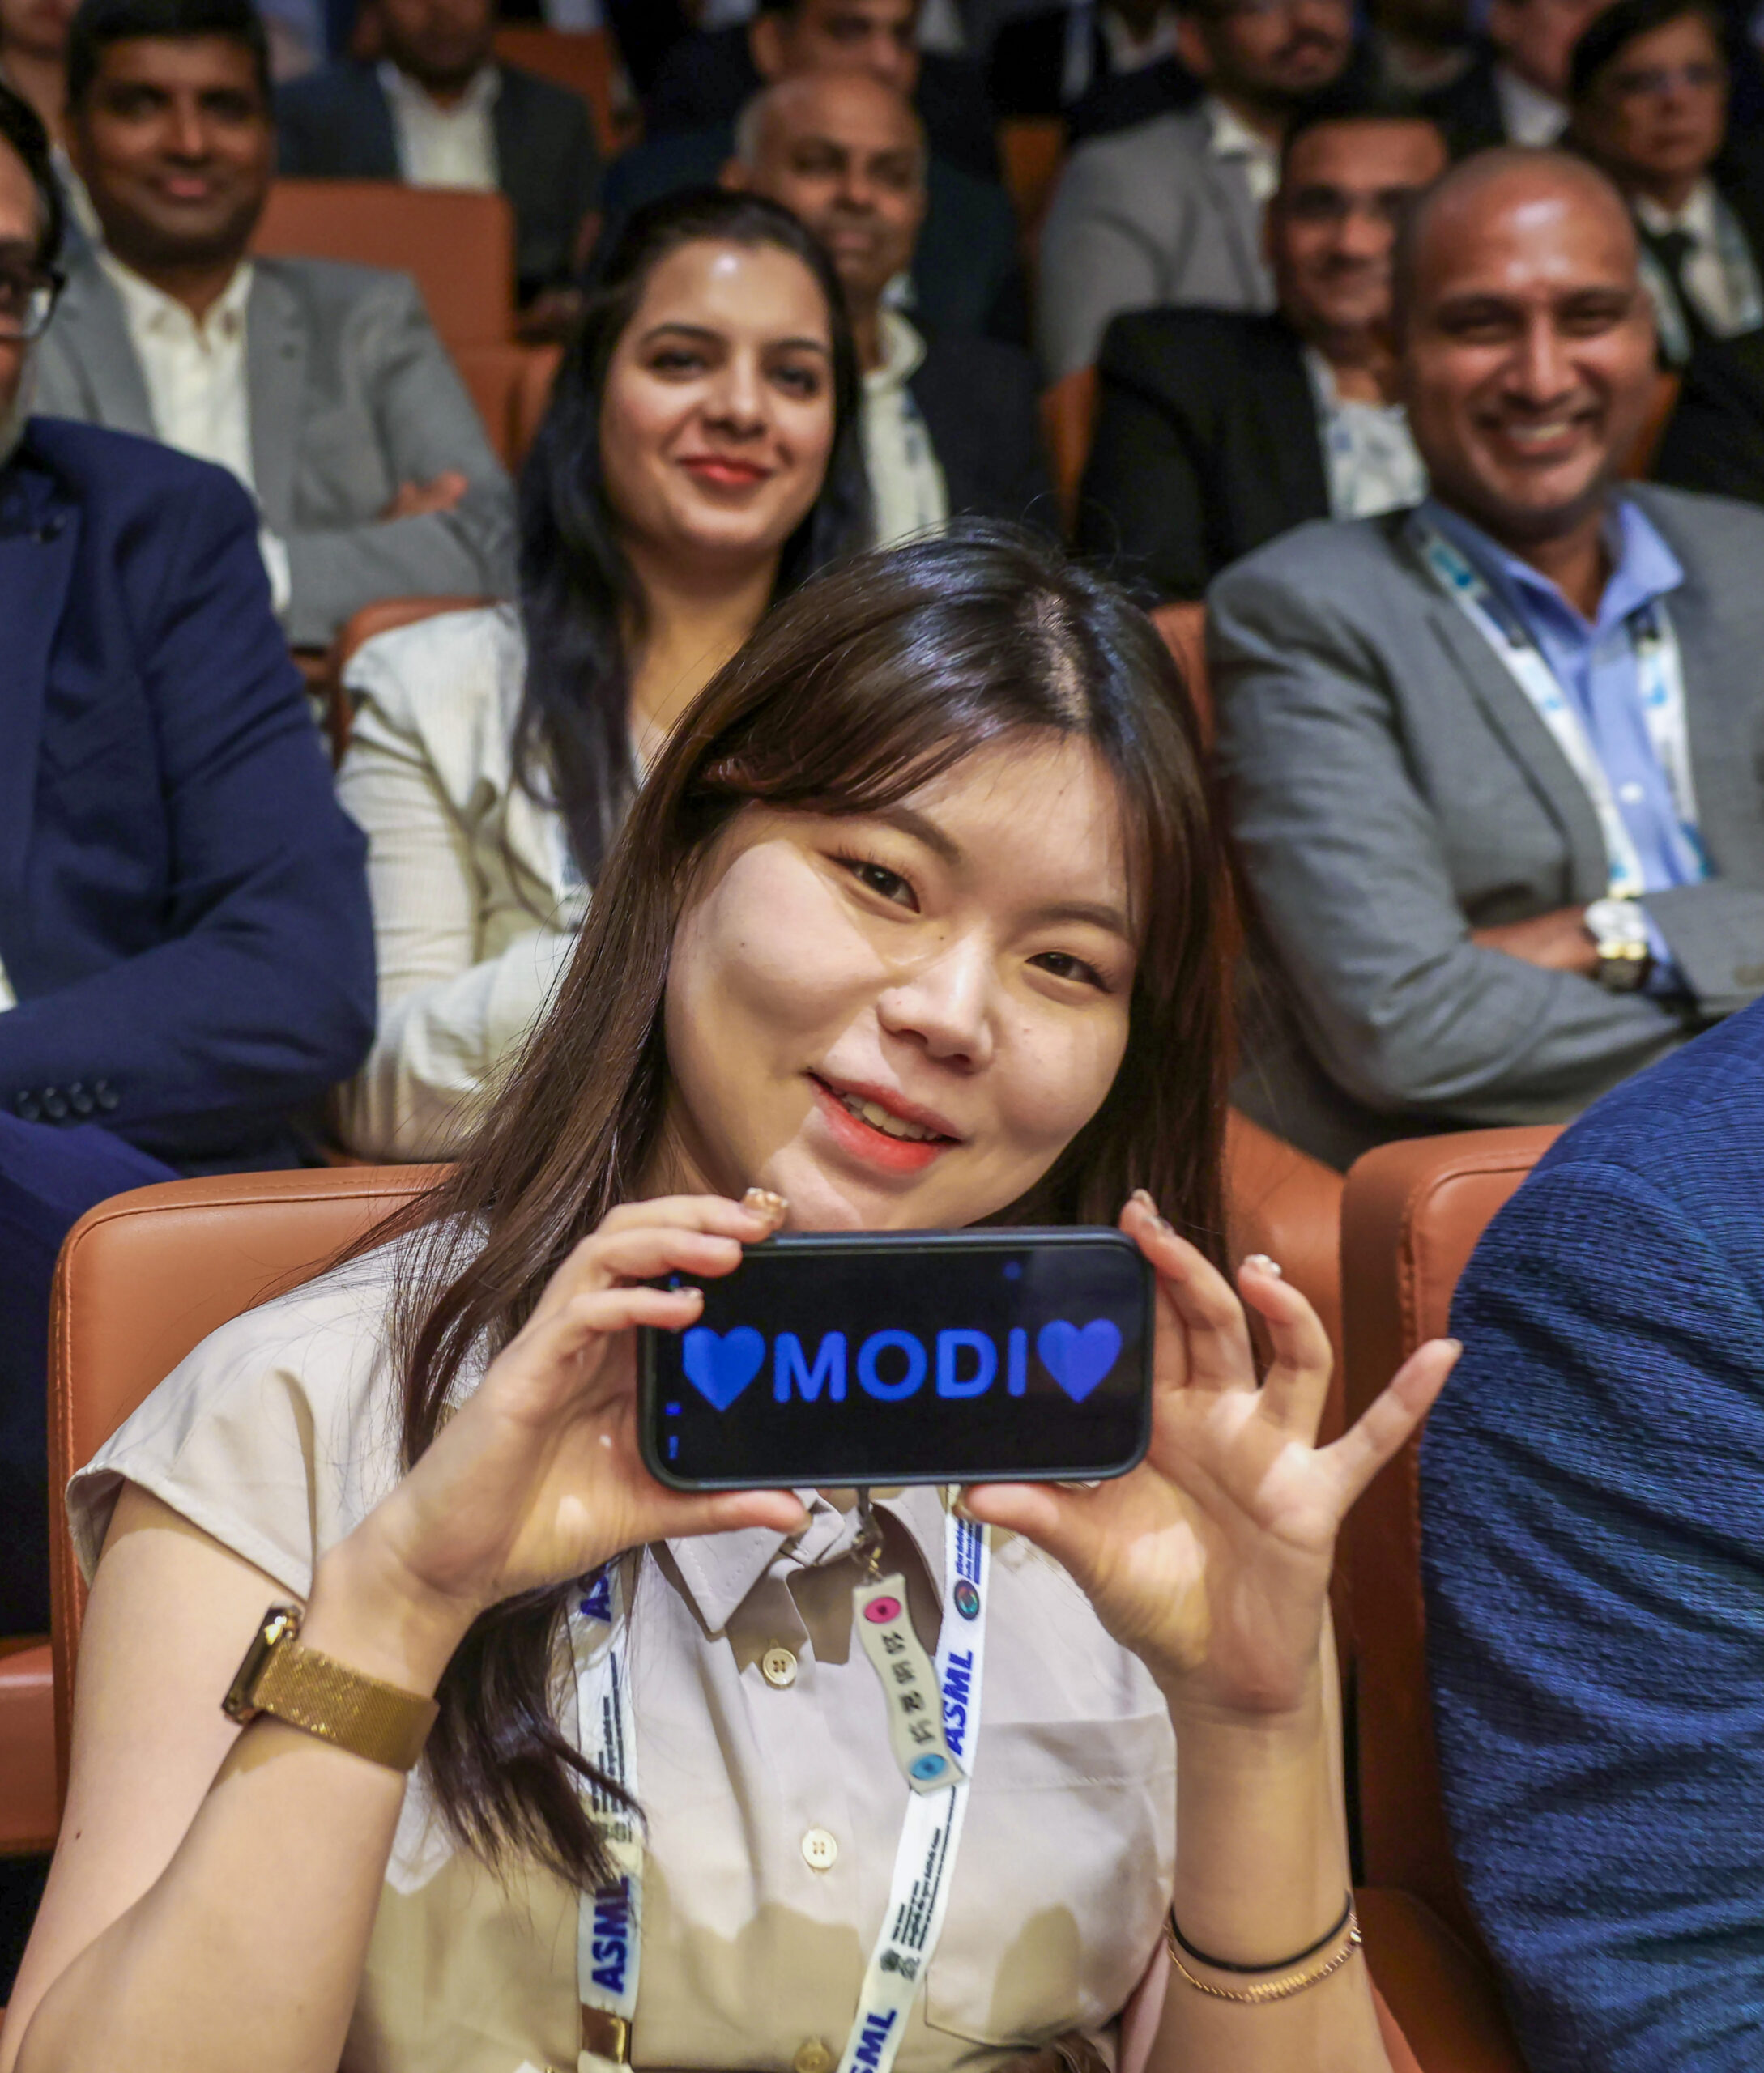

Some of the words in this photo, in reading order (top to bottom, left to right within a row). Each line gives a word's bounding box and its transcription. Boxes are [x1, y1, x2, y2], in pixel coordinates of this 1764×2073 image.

[773, 1327, 1028, 1403] MODI
[942, 1650, 974, 1756] ASML
[591, 1875, 630, 1995] ASML
